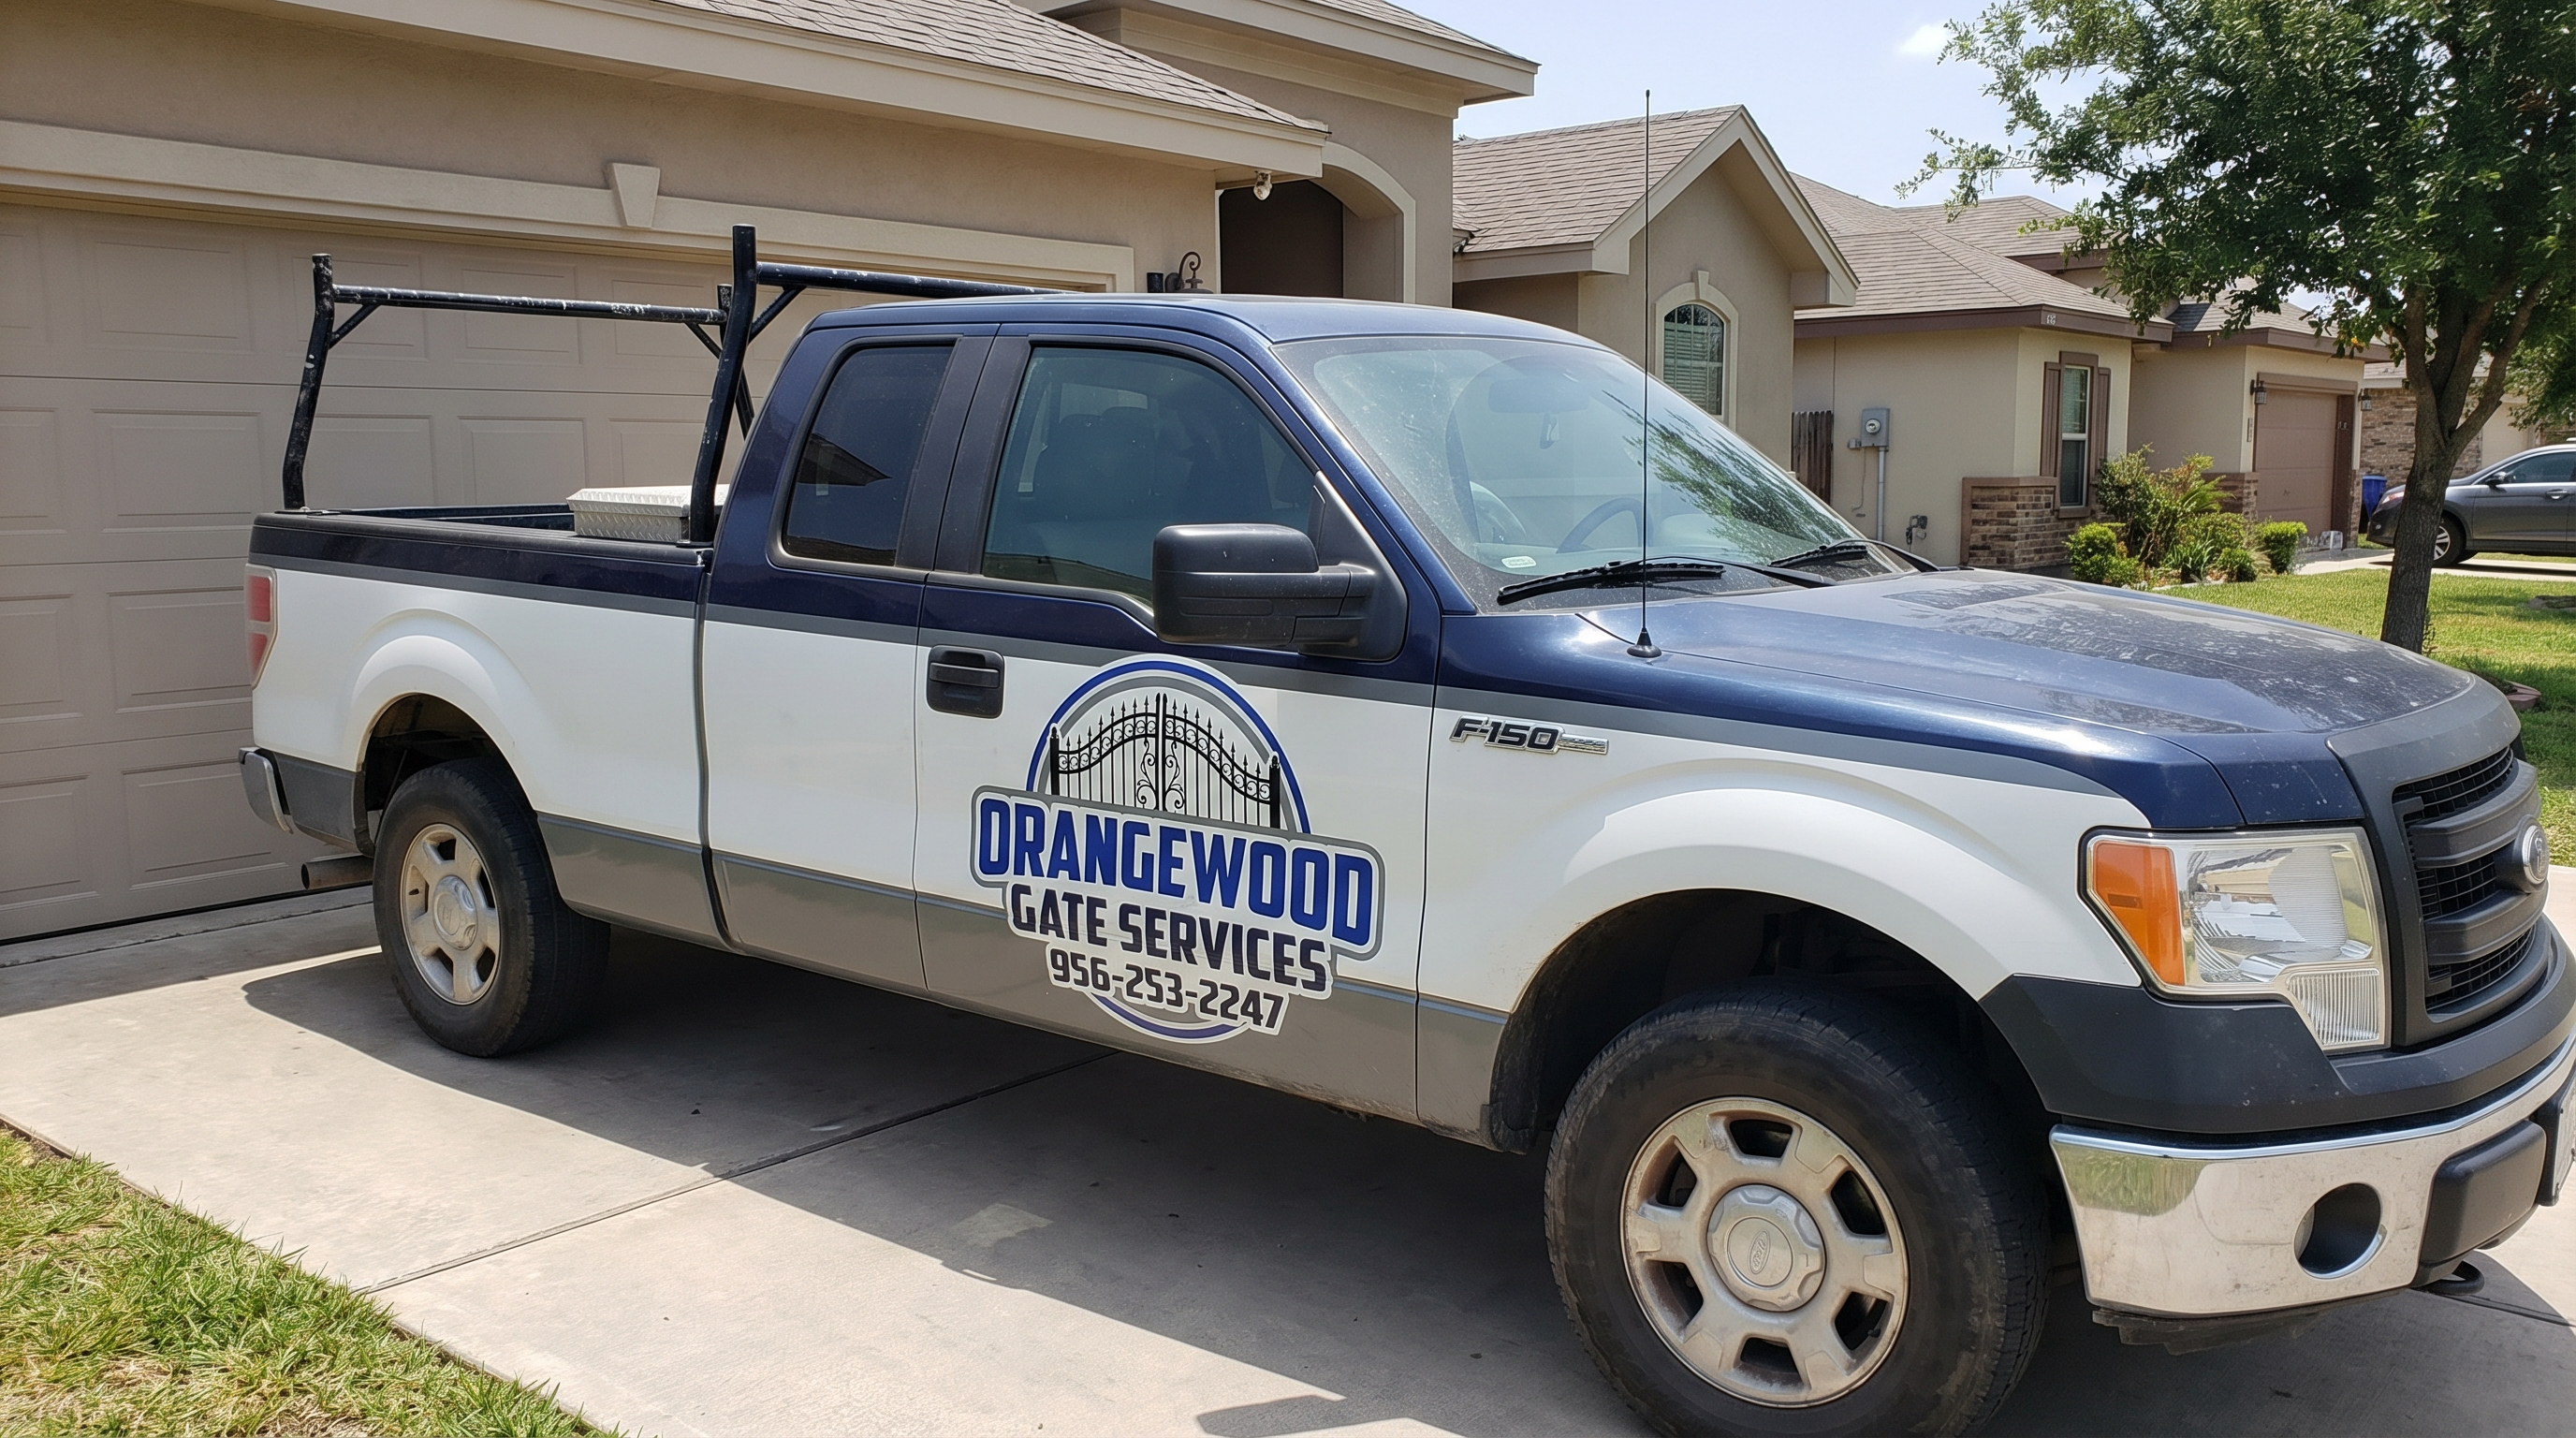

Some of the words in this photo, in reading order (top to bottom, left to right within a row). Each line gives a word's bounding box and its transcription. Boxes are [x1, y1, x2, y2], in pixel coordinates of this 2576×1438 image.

[1451, 716, 1562, 754] F-150
[979, 799, 1372, 946] ORANGEWOOD
[1011, 884, 1107, 946] GATE
[1119, 903, 1326, 992] SERVICES
[1050, 948, 1283, 1029] 956-253-2247
